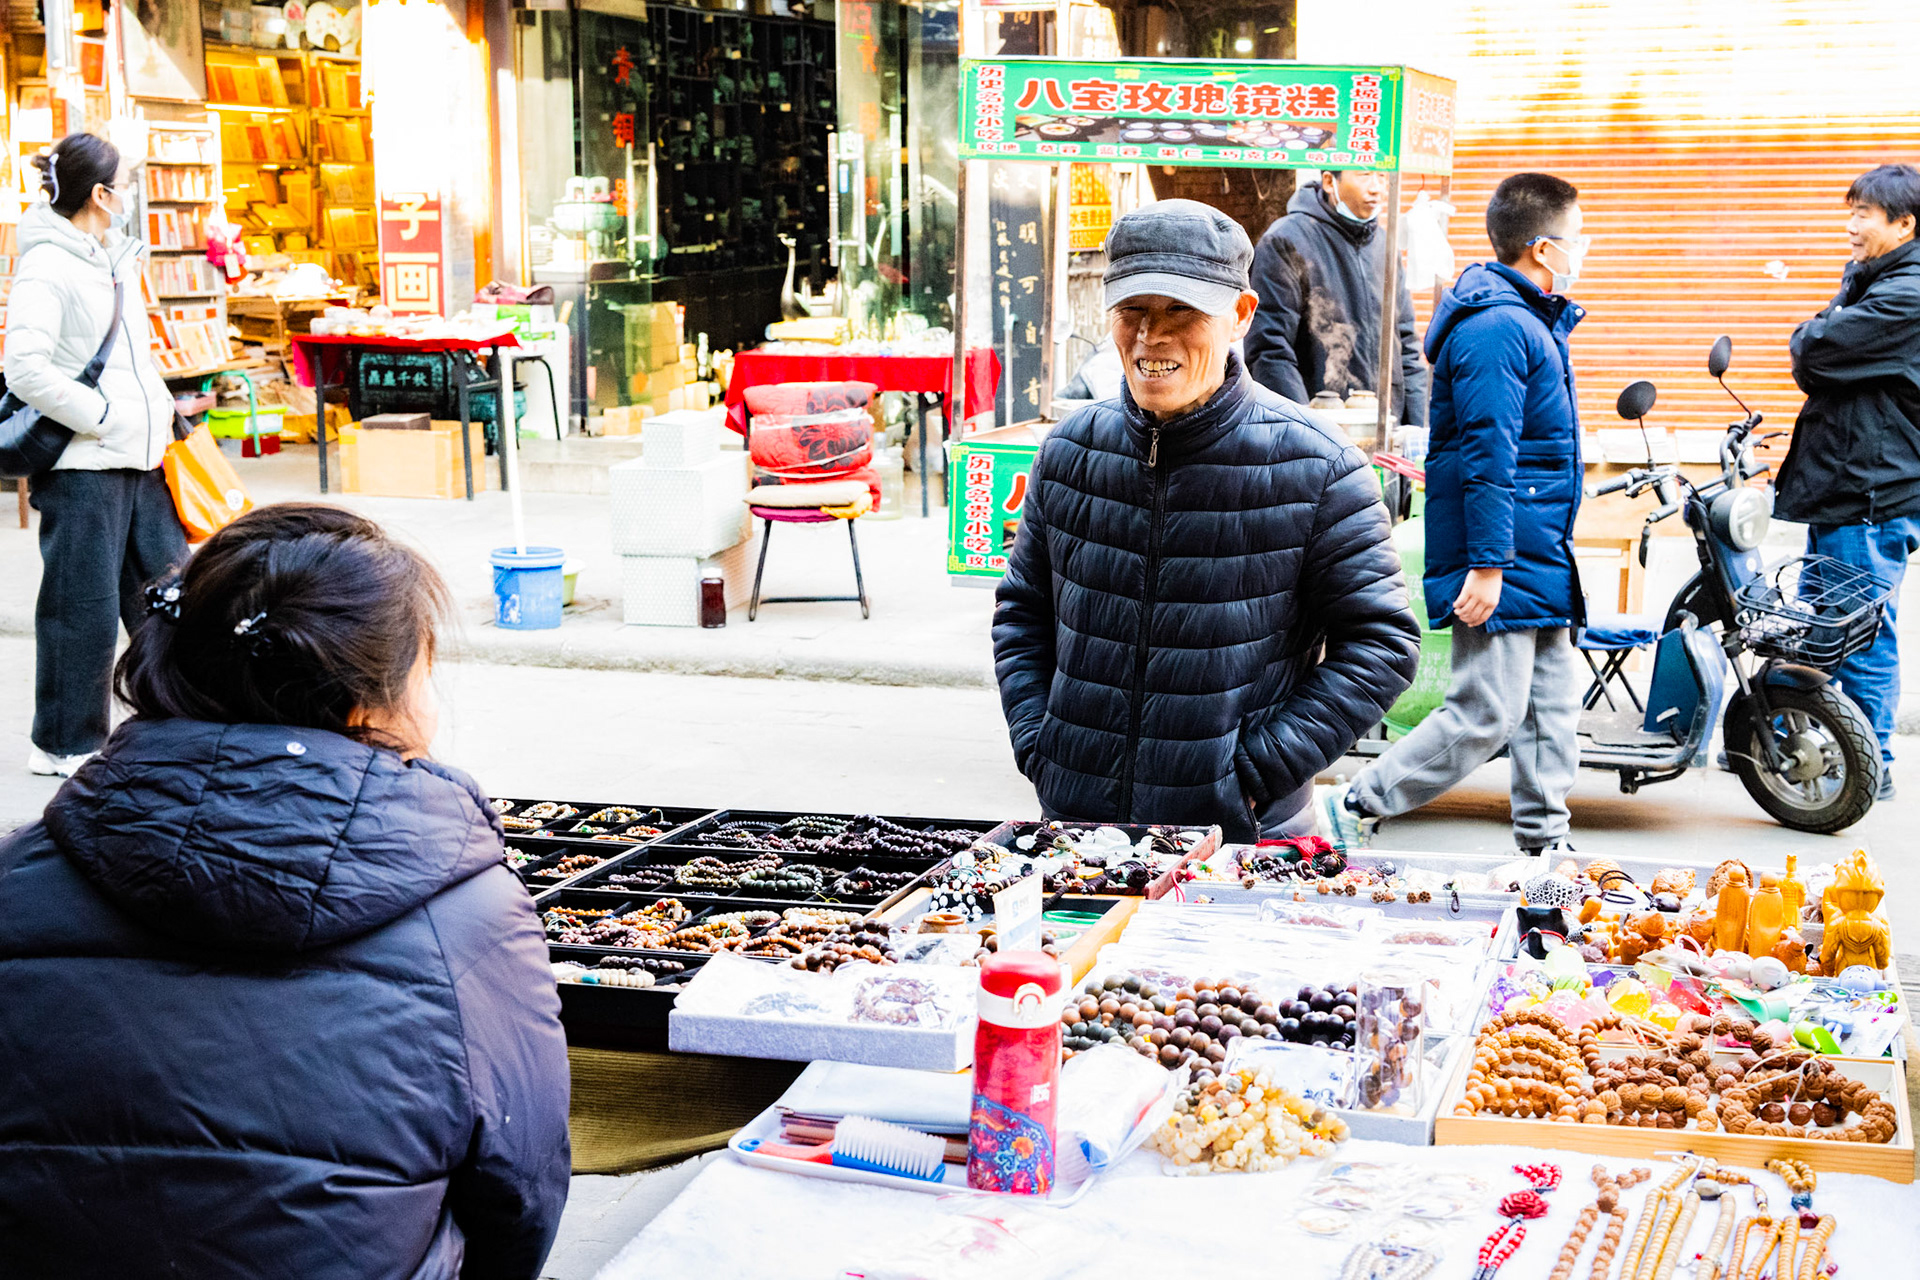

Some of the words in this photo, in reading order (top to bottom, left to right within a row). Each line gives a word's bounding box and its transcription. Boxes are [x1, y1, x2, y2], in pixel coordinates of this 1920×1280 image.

[977, 66, 1003, 140] 历史名贵小吃
[1016, 79, 1338, 118] 八宝玫瑰镜糕
[1350, 75, 1381, 152] 古城回坊风味
[1220, 151, 1287, 160] 巧克力
[1307, 153, 1376, 163] 哈密瓜
[966, 455, 991, 552] 历史名贵小吃
